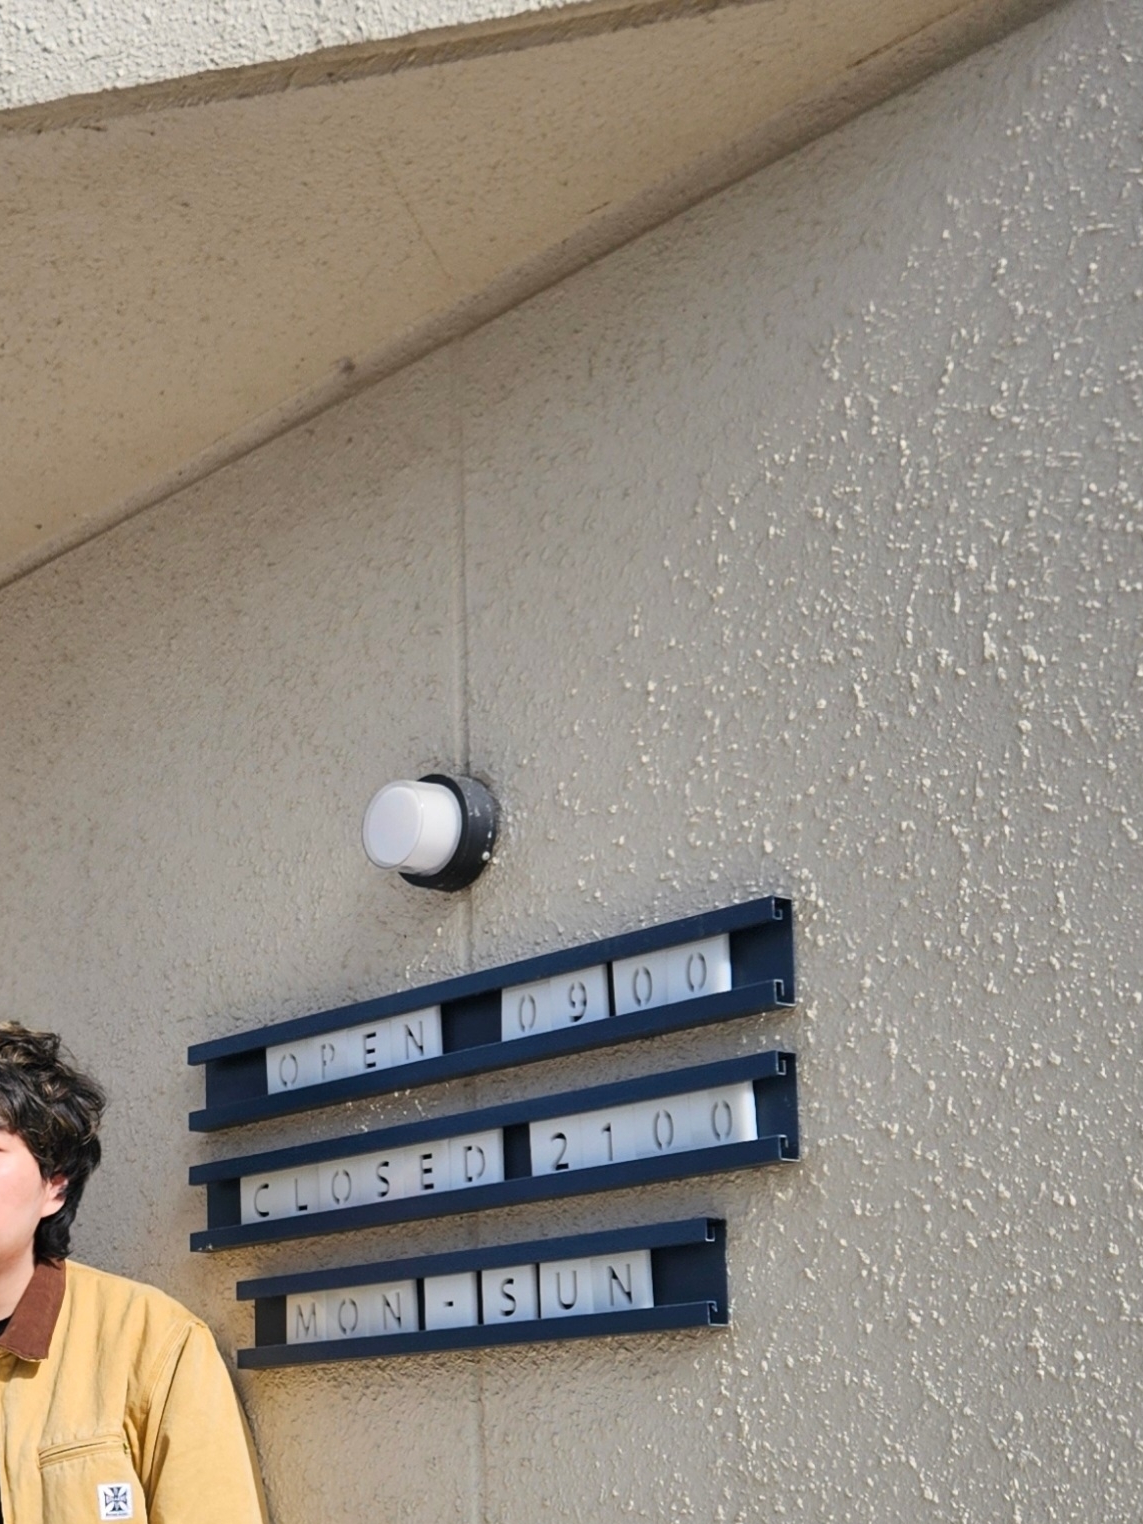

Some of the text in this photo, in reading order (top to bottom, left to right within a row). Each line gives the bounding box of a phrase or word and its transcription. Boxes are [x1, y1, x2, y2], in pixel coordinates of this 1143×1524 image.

[278, 951, 708, 1088] OPEN 0900
[253, 1099, 734, 1219] CLOSED 2100
